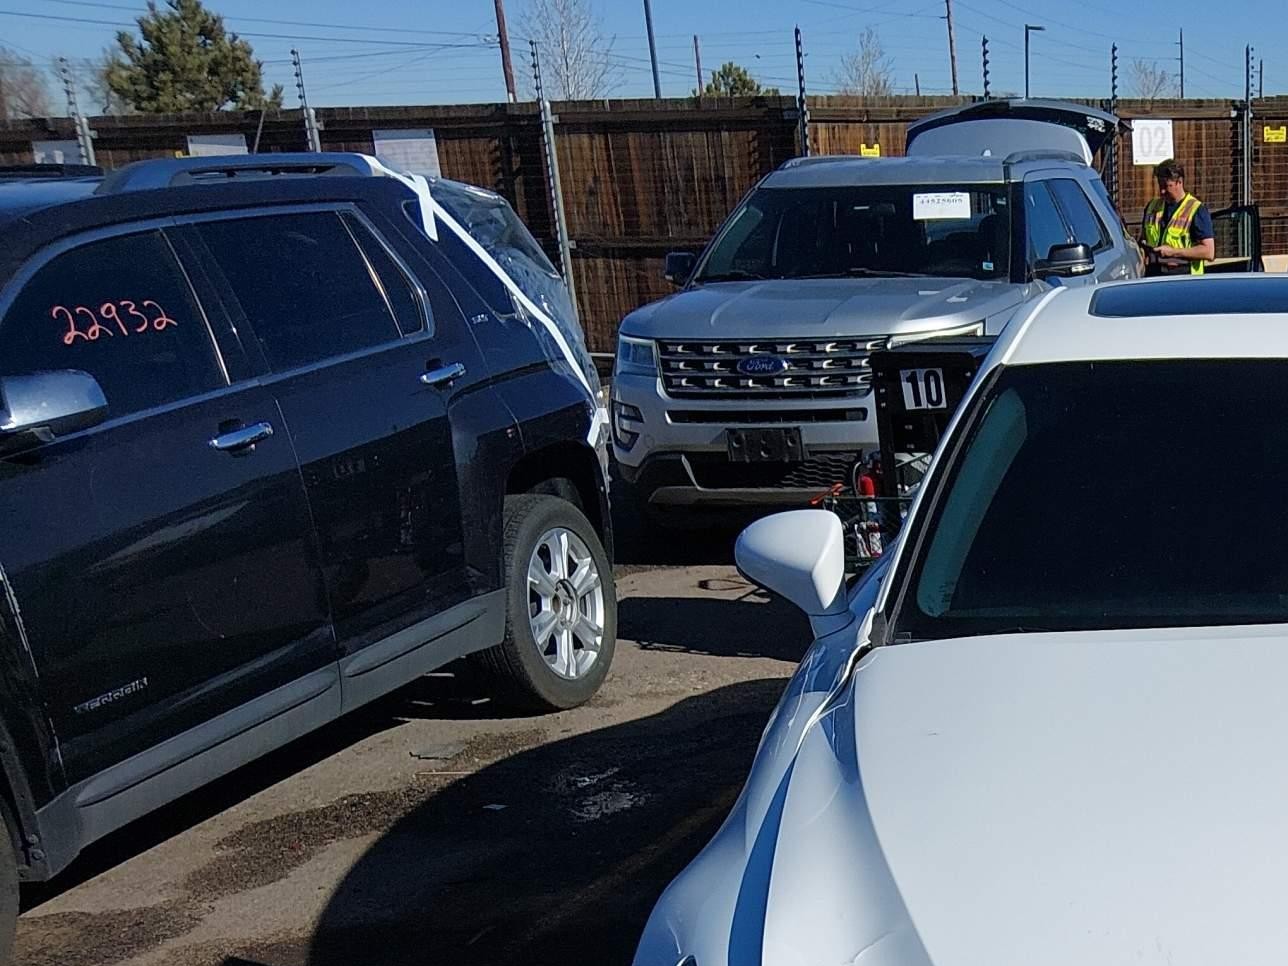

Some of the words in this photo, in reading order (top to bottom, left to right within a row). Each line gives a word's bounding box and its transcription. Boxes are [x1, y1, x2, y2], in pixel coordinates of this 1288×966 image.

[1139, 126, 1169, 158] 02
[52, 300, 178, 345] 22932
[904, 369, 944, 408] 10
